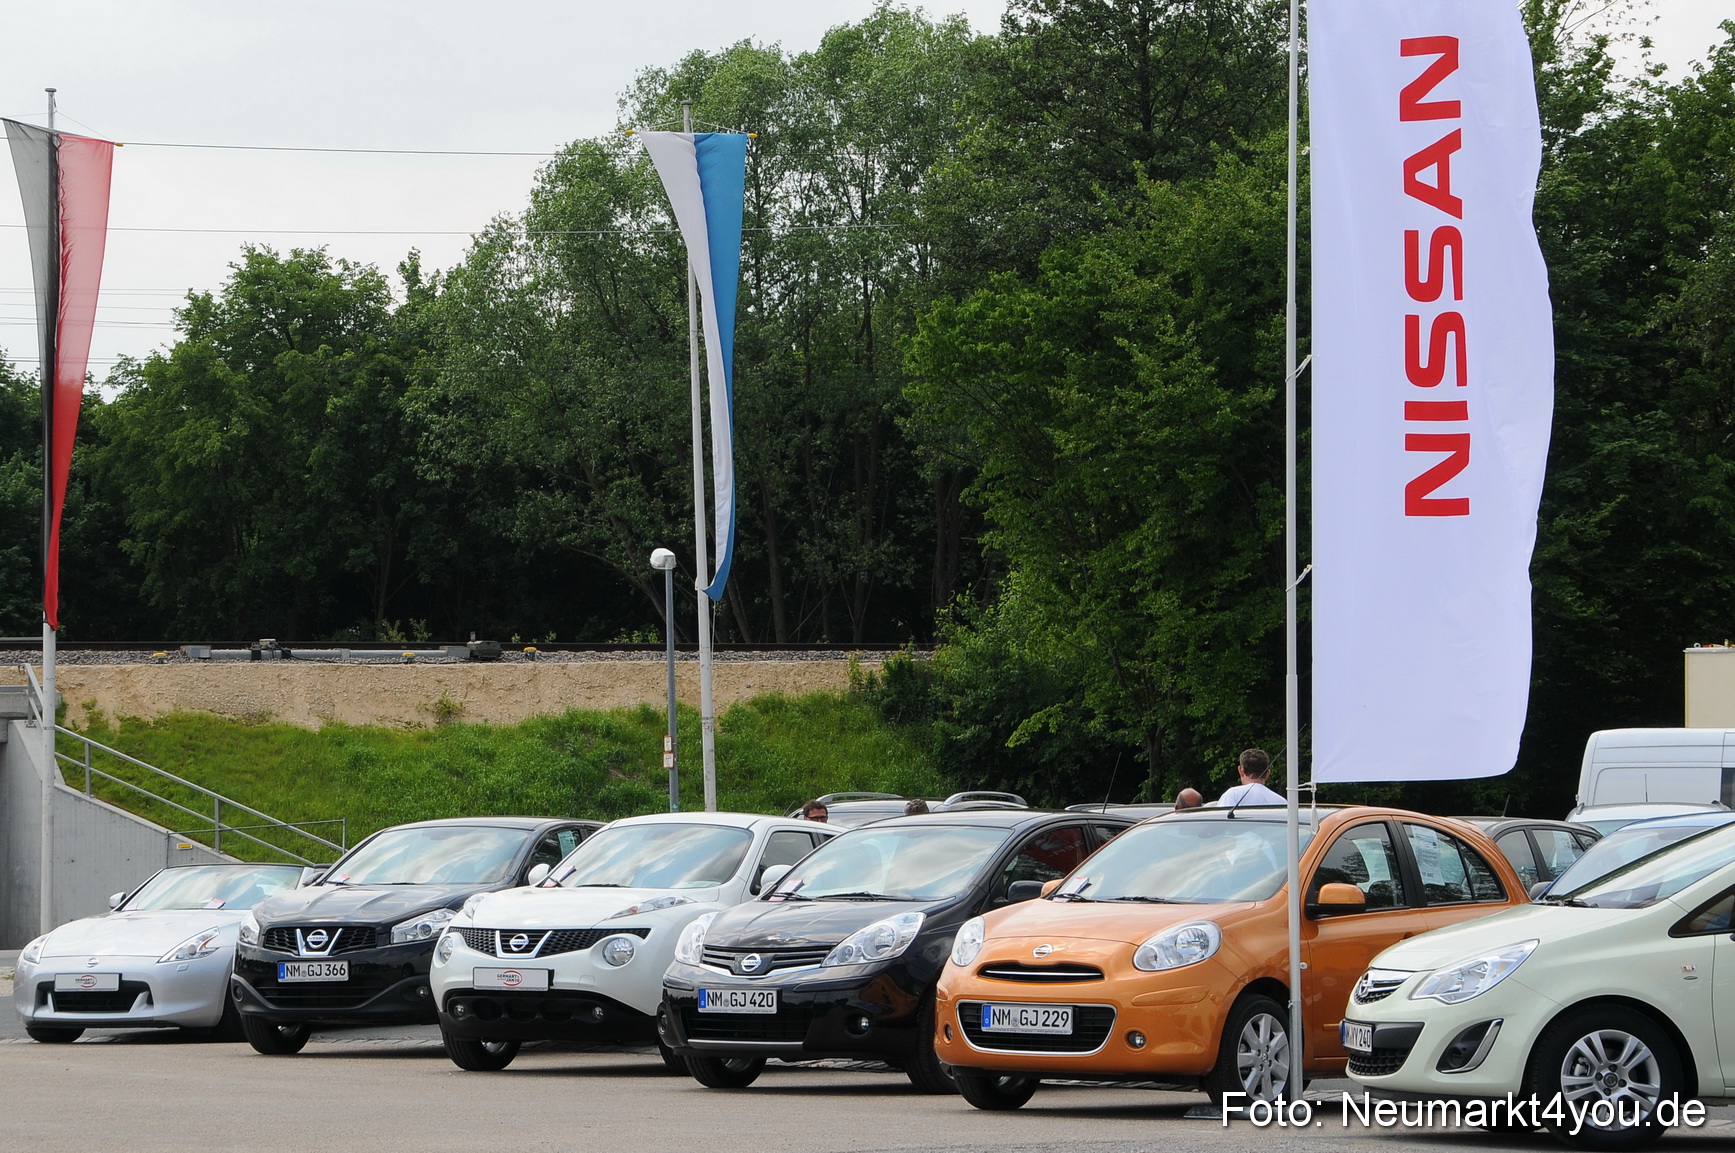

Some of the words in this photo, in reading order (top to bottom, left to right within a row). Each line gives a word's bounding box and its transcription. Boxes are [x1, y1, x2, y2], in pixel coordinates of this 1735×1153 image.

[1400, 35, 1470, 516] NISSAN
[286, 964, 300, 977] NM
[325, 964, 346, 977] 366
[707, 992, 722, 1007] NM
[749, 992, 774, 1008] 420
[992, 1008, 1011, 1026] NM
[1042, 1010, 1070, 1028] 229
